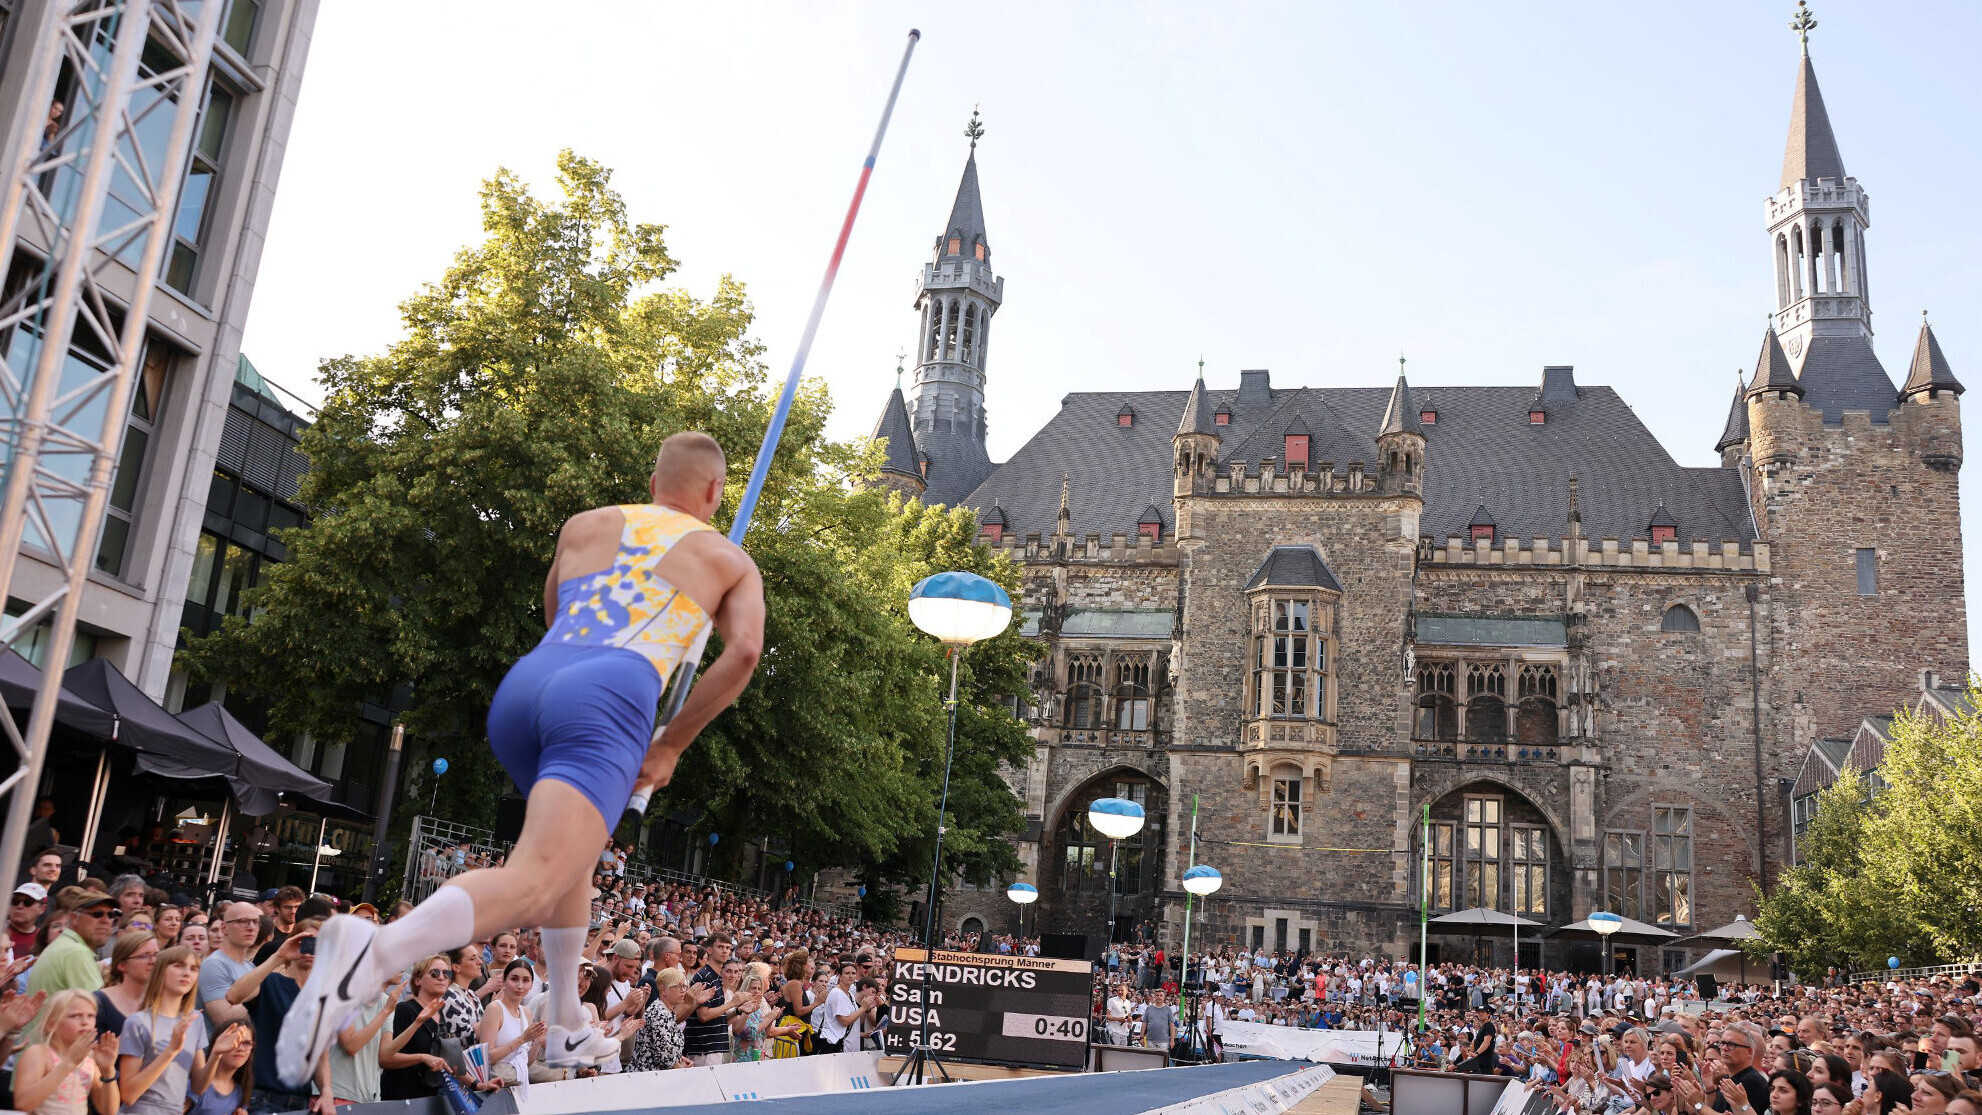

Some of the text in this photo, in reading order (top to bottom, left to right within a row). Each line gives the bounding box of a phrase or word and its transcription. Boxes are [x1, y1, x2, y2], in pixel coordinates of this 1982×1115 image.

[931, 952, 1014, 967] Stabhochsprung
[895, 962, 1036, 989] KENDRICKS
[890, 1005, 941, 1028] USA
[1034, 1018, 1085, 1038] 0:40
[887, 1030, 957, 1052] H: 562
